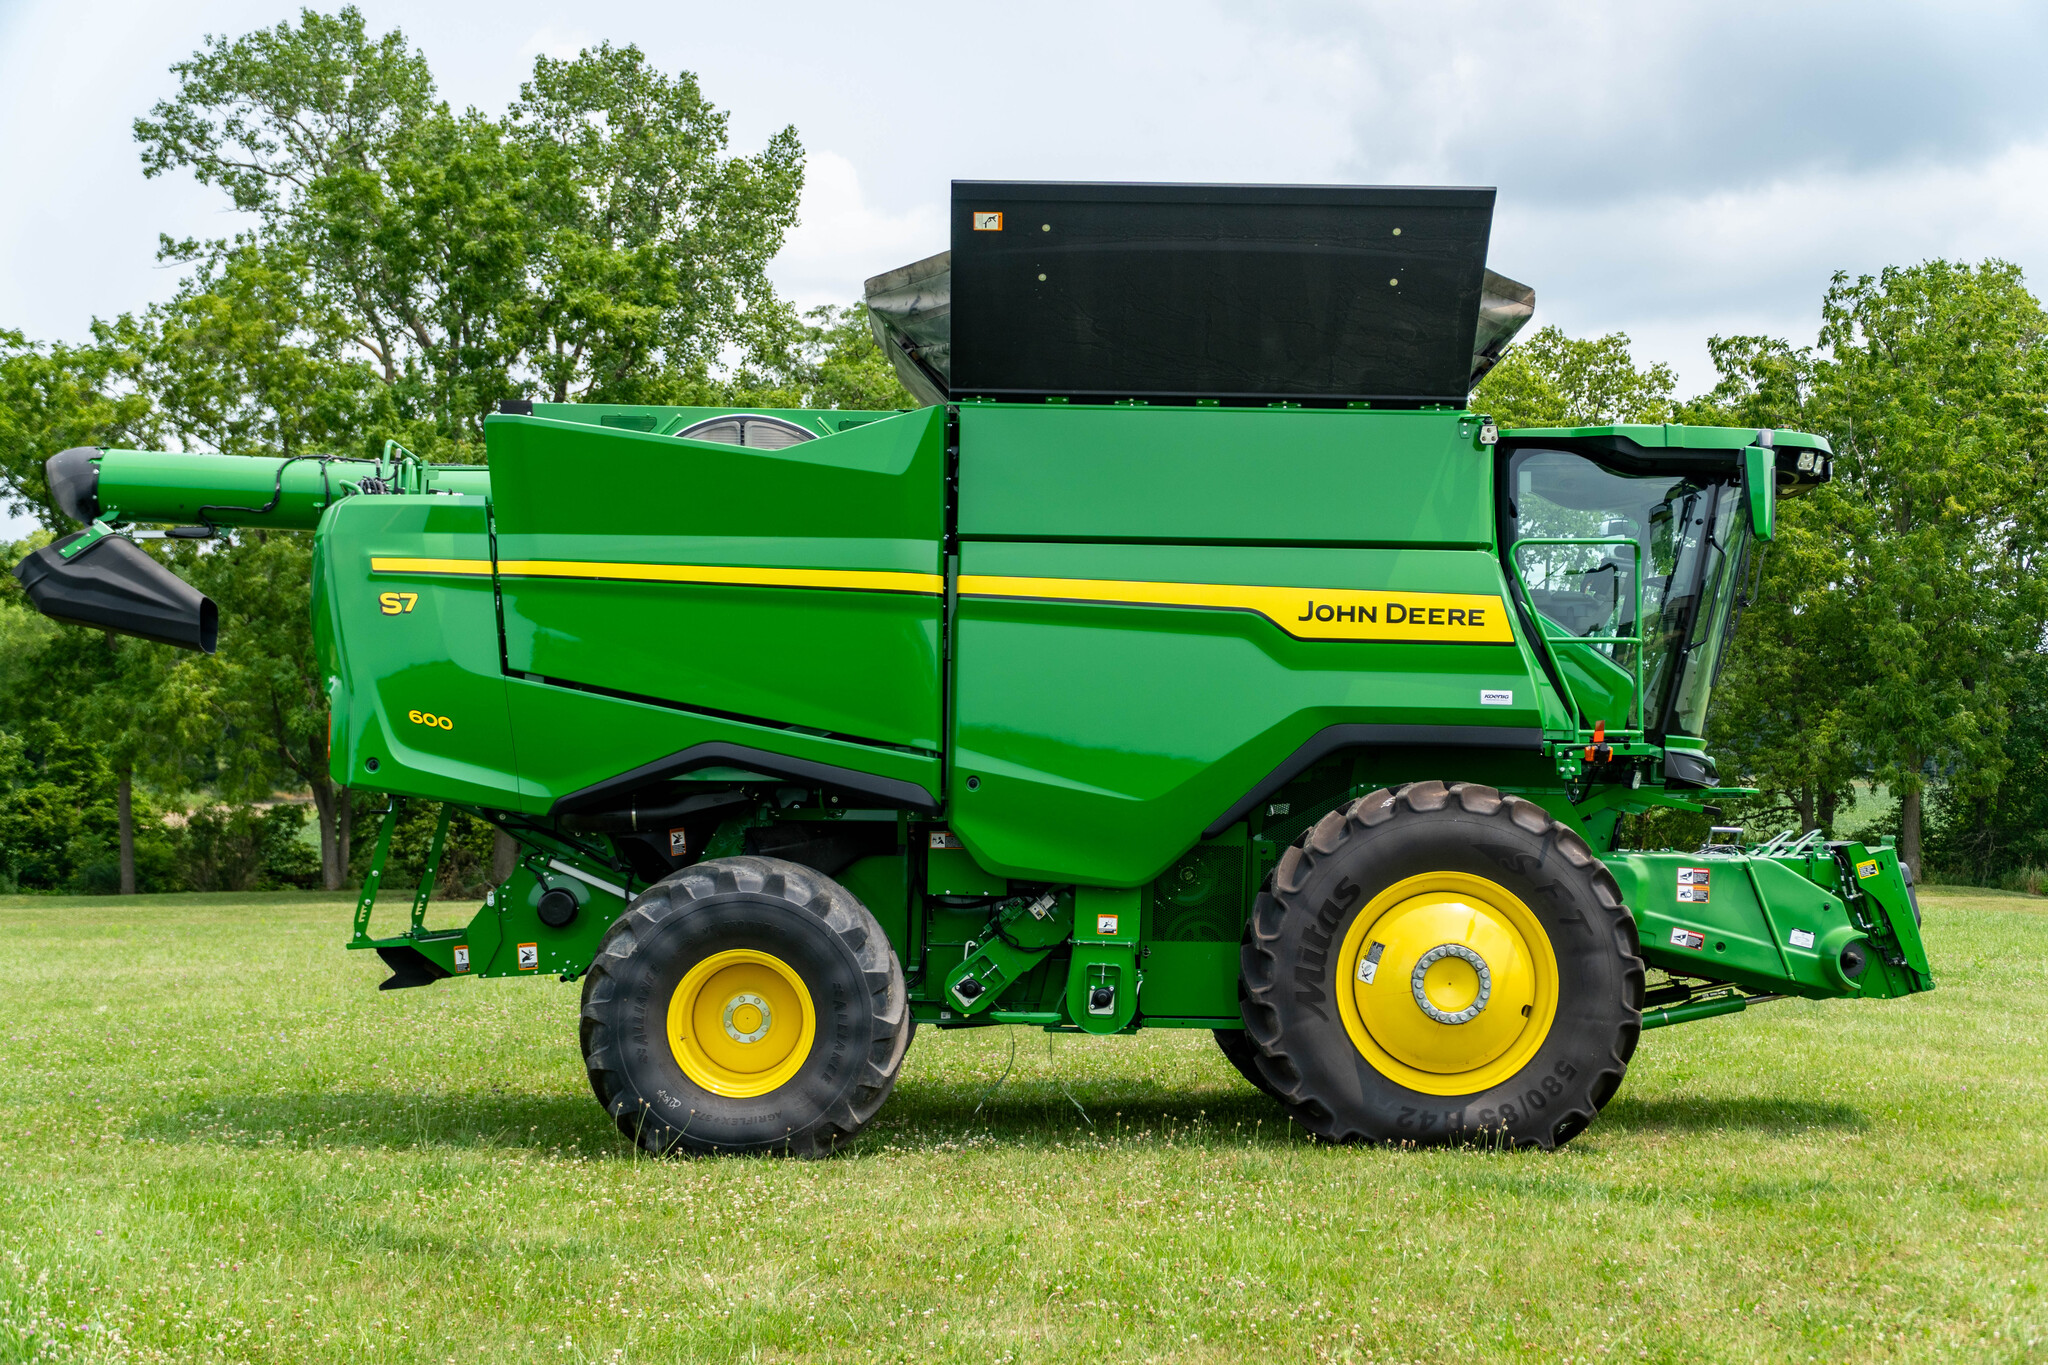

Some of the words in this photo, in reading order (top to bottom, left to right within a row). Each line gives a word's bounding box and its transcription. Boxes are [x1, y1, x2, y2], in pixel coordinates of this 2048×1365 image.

[378, 591, 419, 616] S7
[1298, 600, 1377, 623] JOHN
[1386, 602, 1485, 626] DEERE
[408, 709, 454, 731] 600
[1295, 875, 1361, 1023] Mitas
